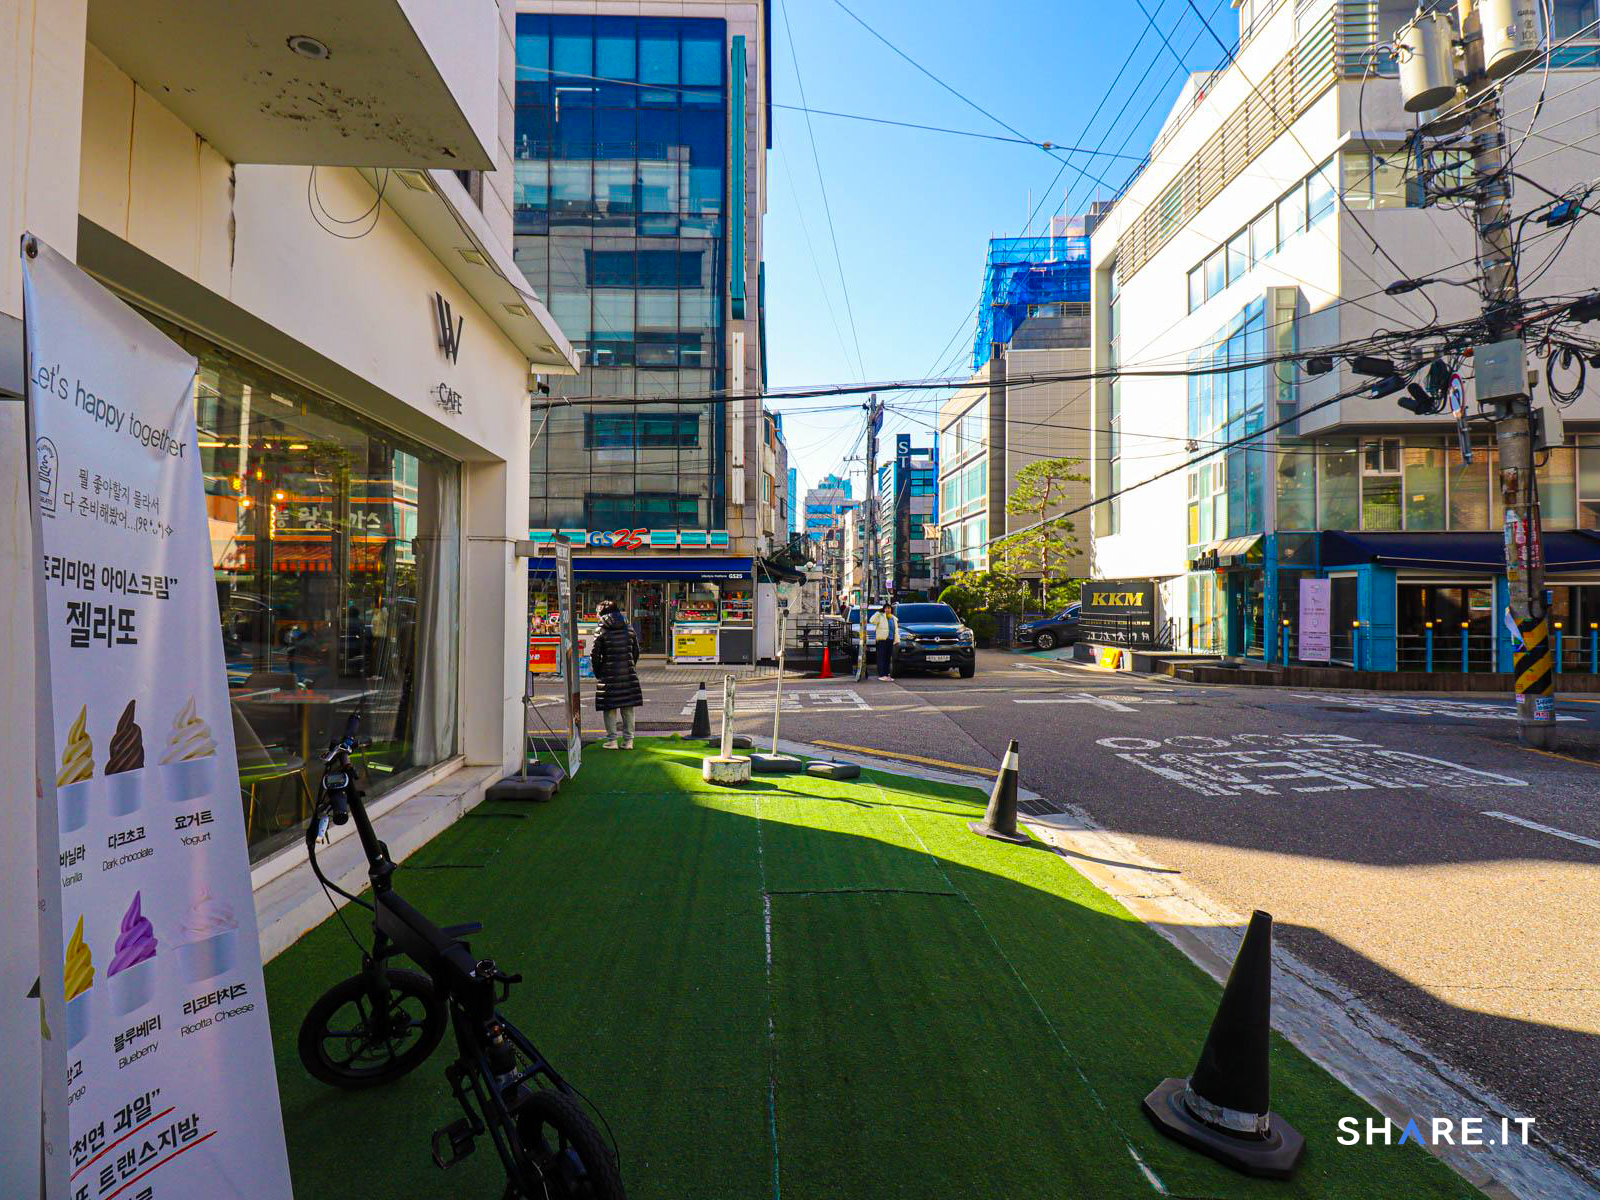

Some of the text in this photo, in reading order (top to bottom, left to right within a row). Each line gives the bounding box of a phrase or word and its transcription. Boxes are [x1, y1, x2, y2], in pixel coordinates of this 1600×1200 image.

[31, 352, 187, 458] Let's happy together
[439, 382, 463, 415] CAFE
[63, 491, 75, 512] 다
[78, 468, 160, 515] 뭘 좋아할지 몰라서
[589, 527, 648, 551] GS25
[1091, 592, 1144, 606] KKM
[66, 602, 138, 648] 젤라또
[174, 810, 214, 830] 요거트
[108, 826, 146, 849] 다크초코
[180, 831, 211, 847] Yogurt
[59, 844, 86, 868] 바닐라
[102, 846, 154, 872] Dark chocolate
[62, 871, 83, 888] Vanilla
[182, 983, 248, 1016] 리코타치즈
[180, 1003, 255, 1037] Ricotta Cheese
[113, 1015, 162, 1053] 블루베리
[118, 1041, 159, 1070] Blueberry
[98, 1113, 200, 1196] 트랜스지방
